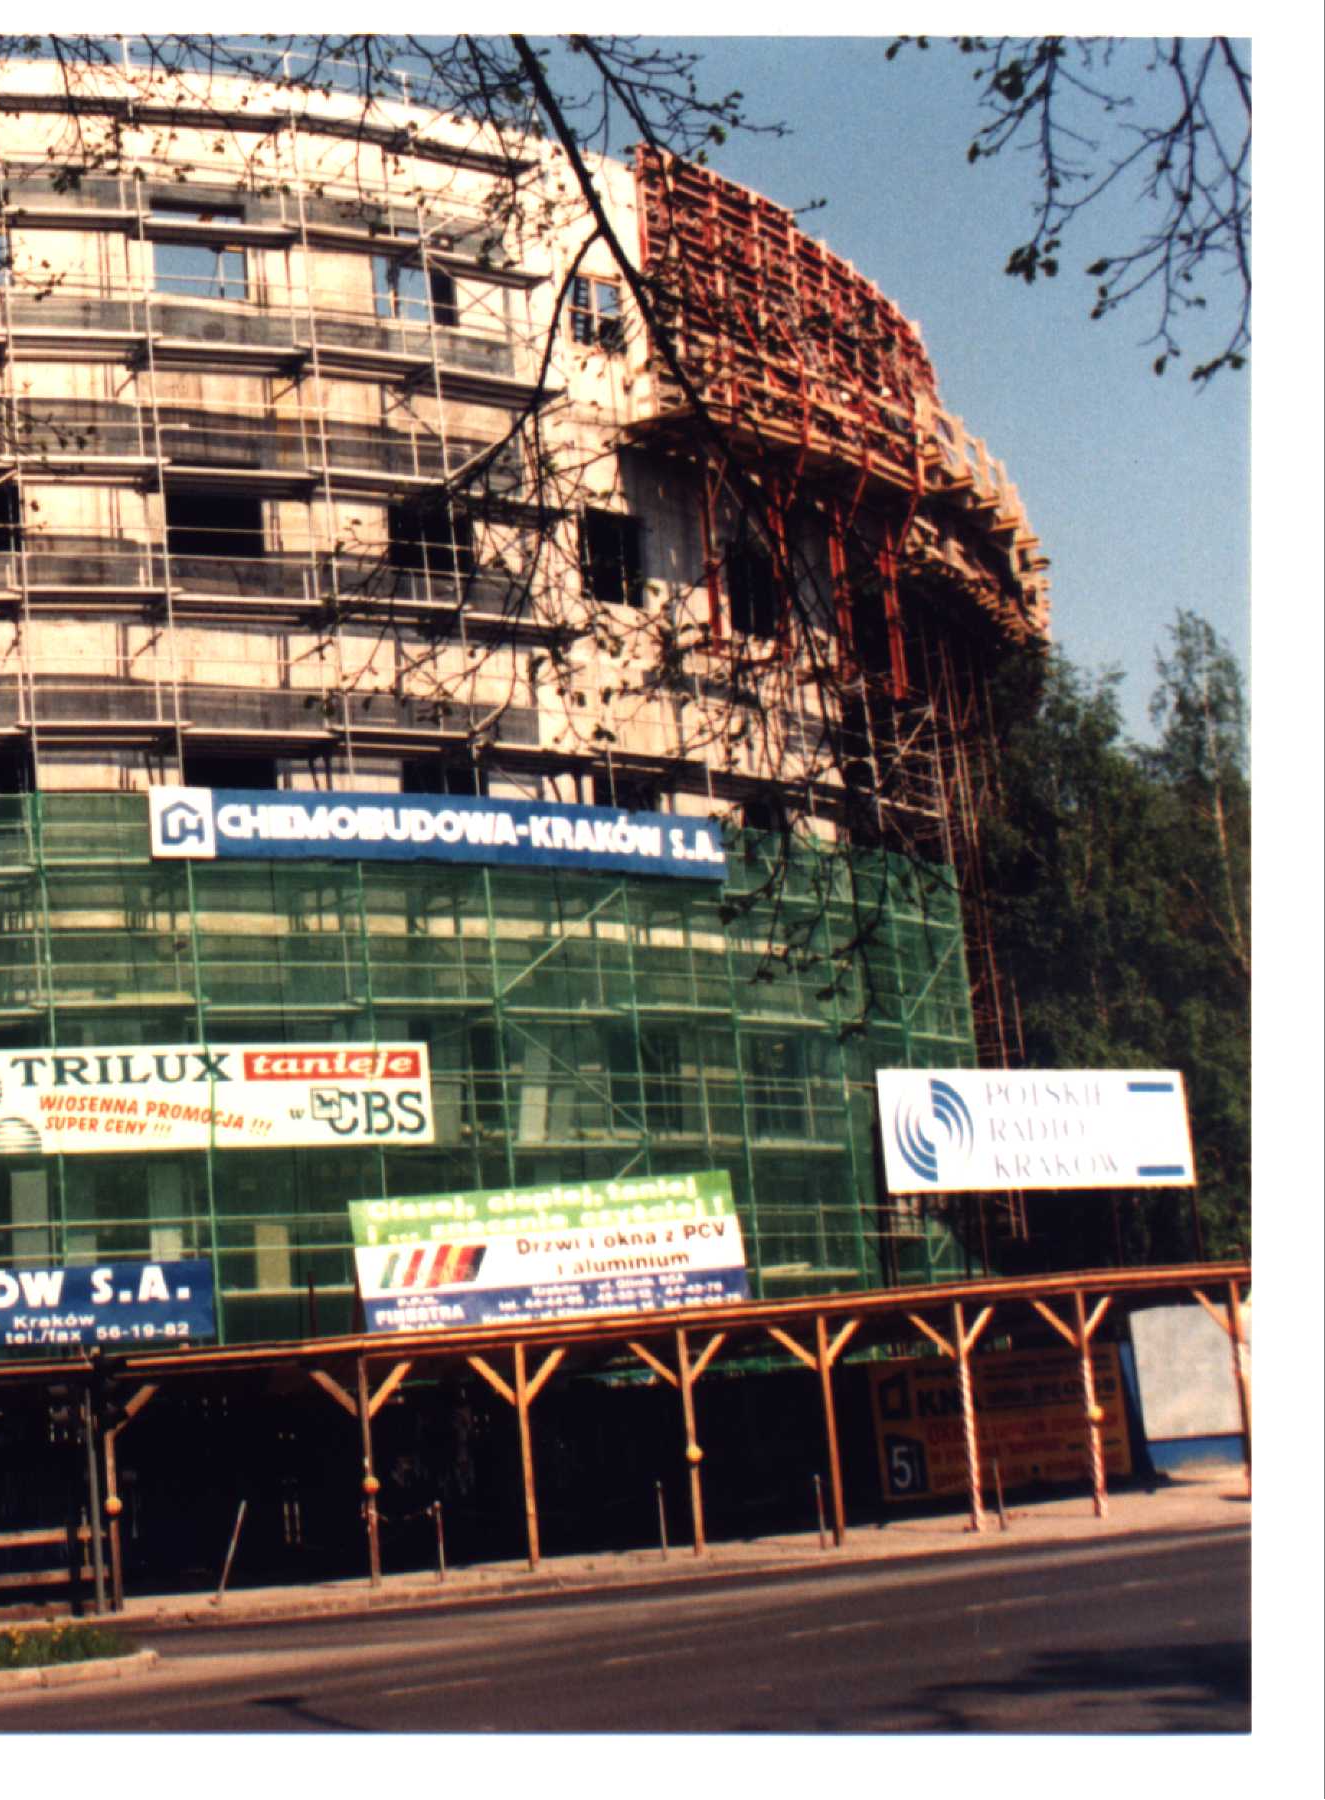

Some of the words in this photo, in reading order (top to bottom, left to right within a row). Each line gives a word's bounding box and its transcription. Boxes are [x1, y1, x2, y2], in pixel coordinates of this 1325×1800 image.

[217, 804, 661, 857] CHEMOBUDOWA-KRAKÓW
[669, 828, 725, 862] S.A.
[10, 1052, 233, 1087] TRILUX
[250, 1054, 416, 1079] tanieje
[39, 1095, 139, 1115] WIOSENNA
[145, 1100, 244, 1131] PROMOCJA
[45, 1116, 98, 1132] SUPER
[104, 1118, 148, 1134] CENY
[327, 1090, 427, 1136] CBS
[988, 1116, 1087, 1143] RADIO
[516, 1236, 580, 1255] Drzwi
[603, 1230, 657, 1247] okna
[665, 1229, 674, 1243] z
[682, 1221, 726, 1240] PCV
[573, 1251, 690, 1276] aluminium
[89, 1264, 191, 1305] S.A.
[12, 1312, 96, 1330] Kraków
